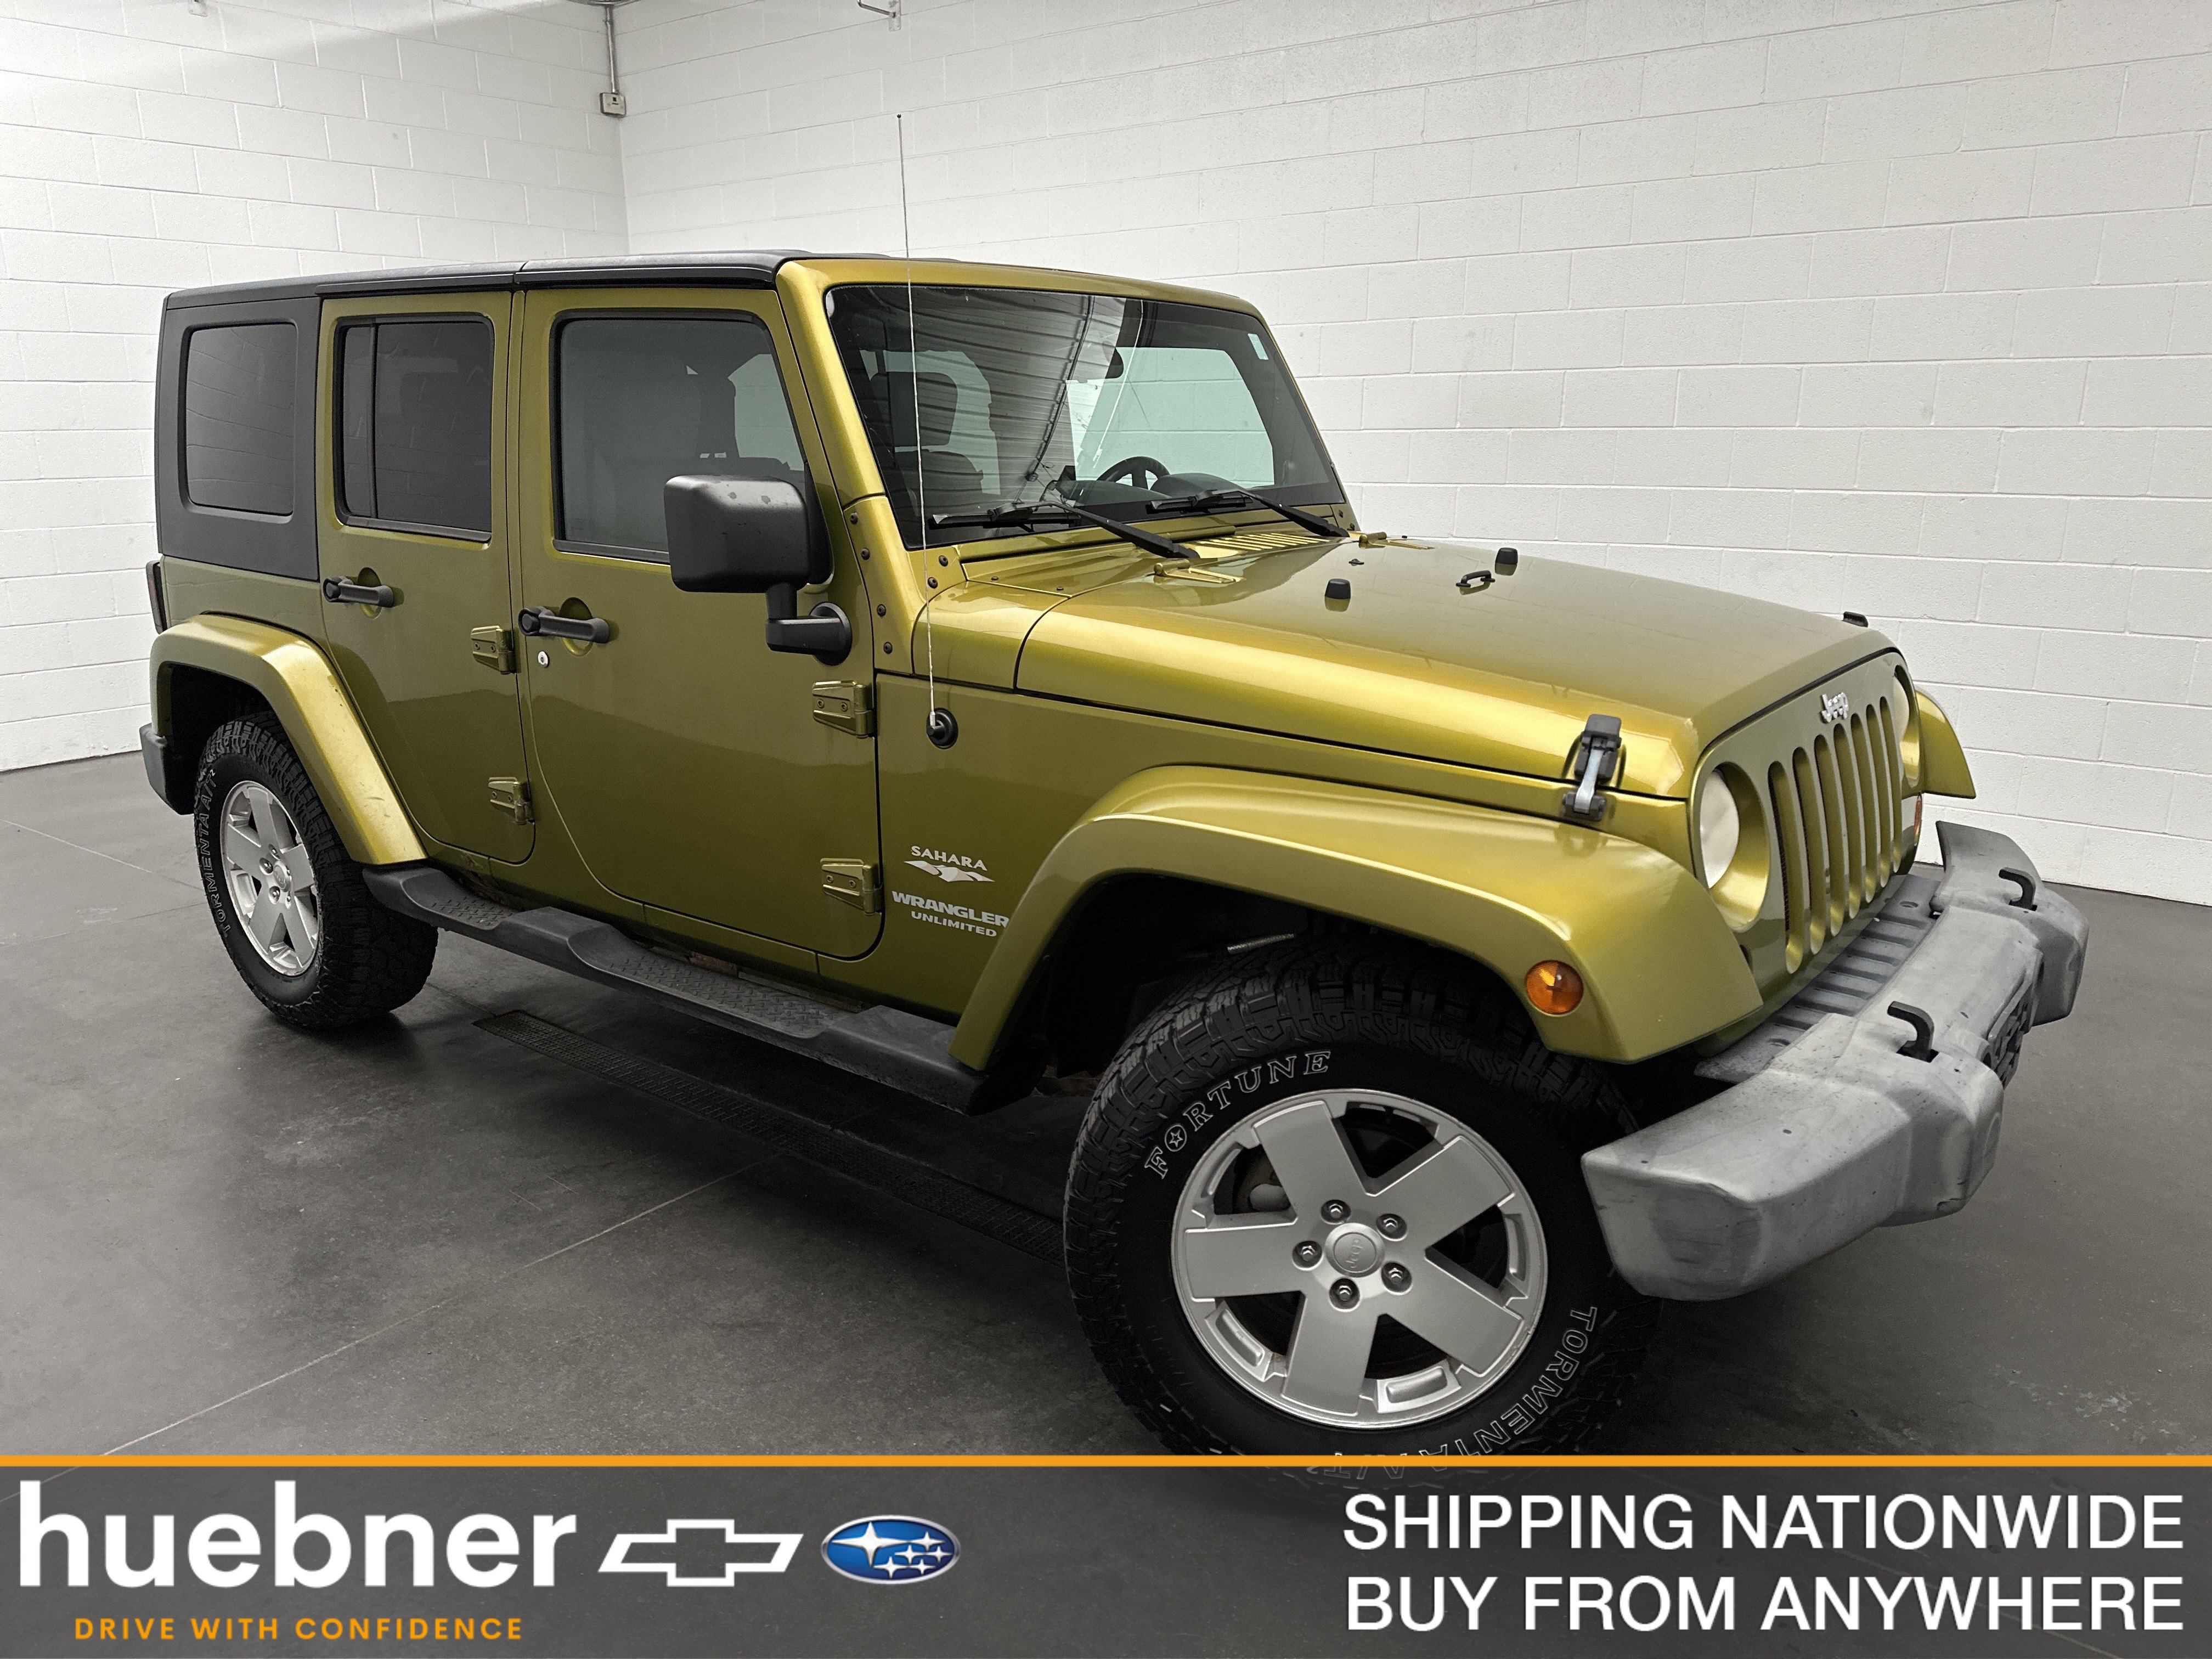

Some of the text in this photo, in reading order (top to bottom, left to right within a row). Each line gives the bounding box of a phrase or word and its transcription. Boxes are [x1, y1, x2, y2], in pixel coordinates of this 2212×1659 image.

[1821, 692, 1849, 723] Jeep
[910, 845, 988, 871] SAHARA
[198, 813, 232, 938] TORMENTA
[891, 890, 1011, 928] WRANGLER
[911, 911, 997, 938] UNLIMITED
[1144, 1049, 1331, 1180] FORTUNE
